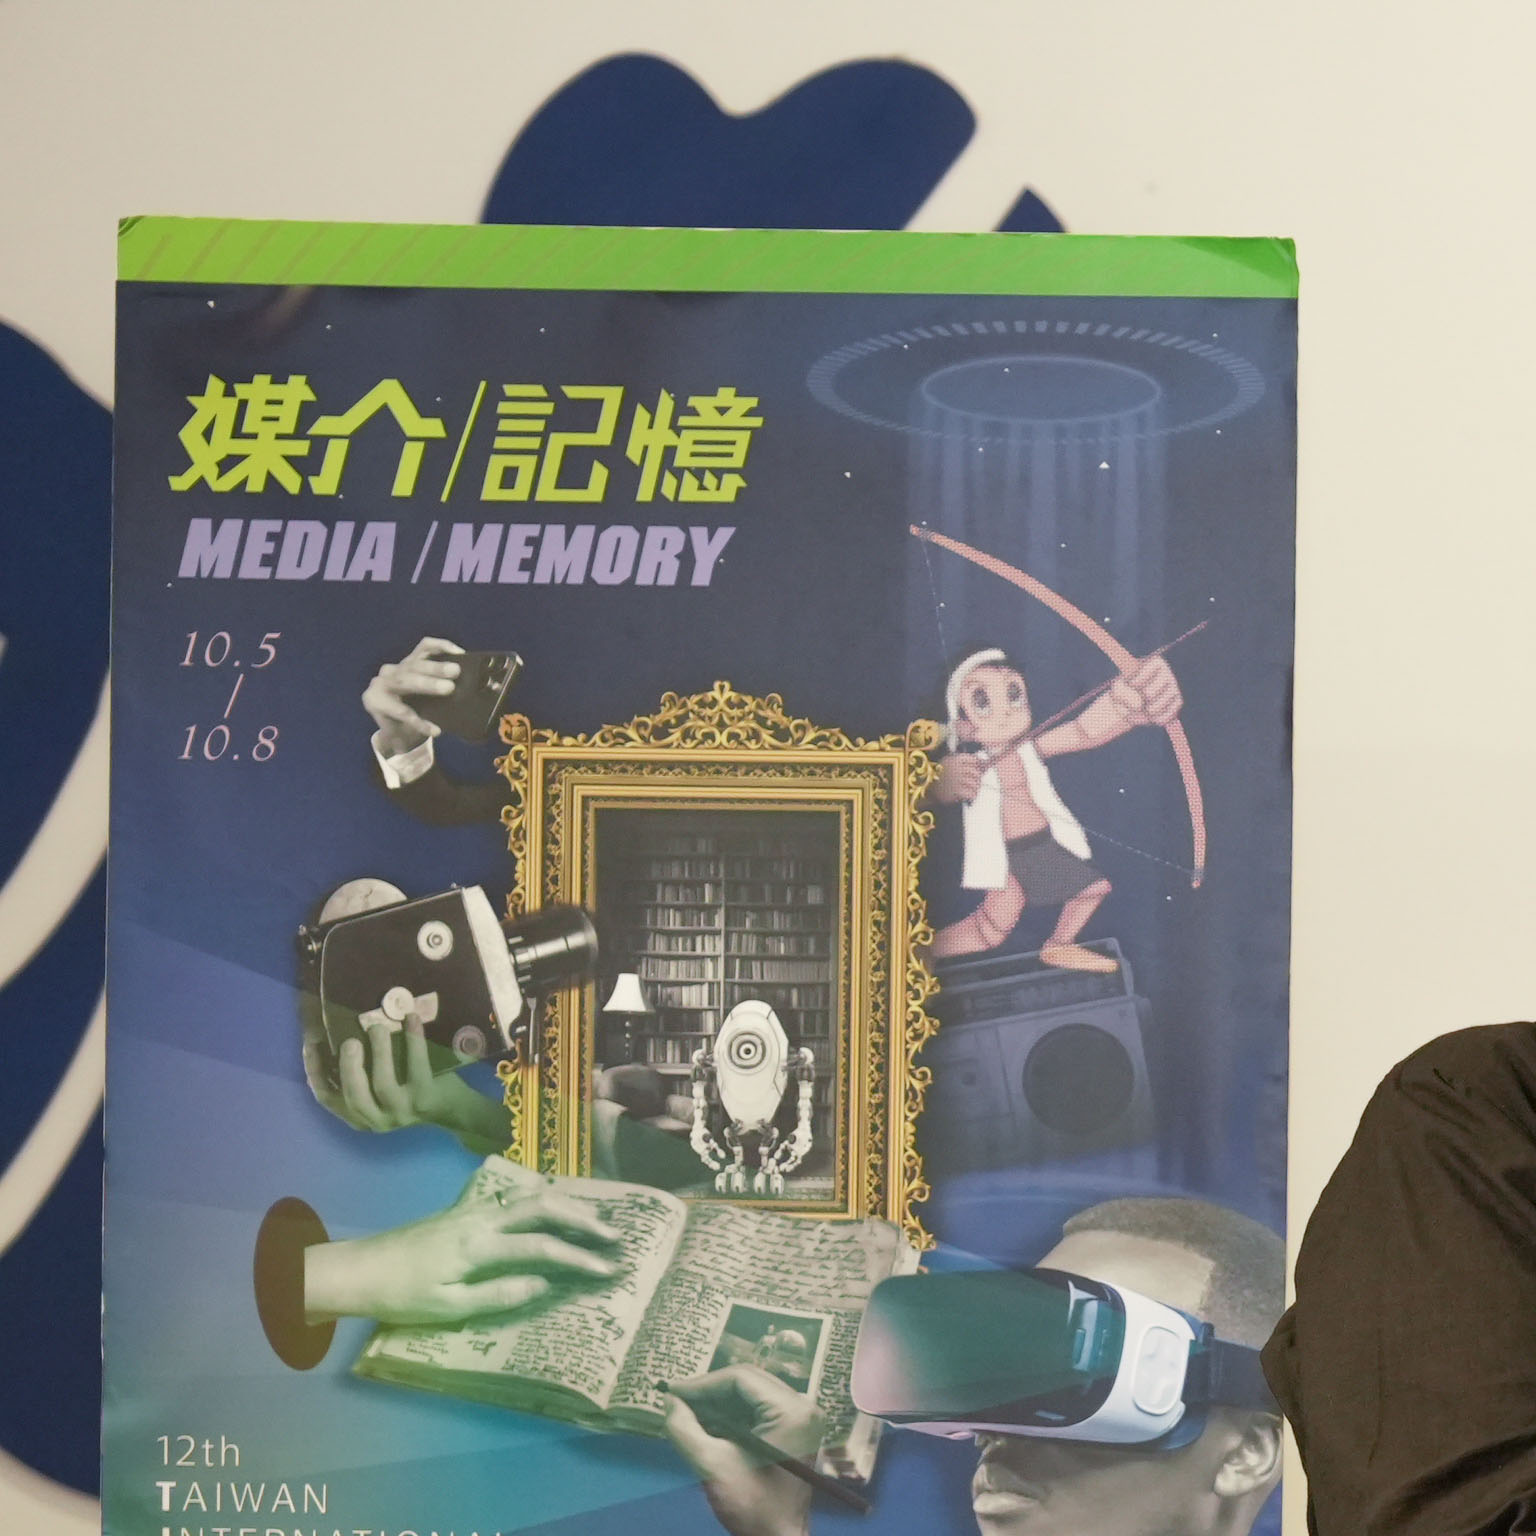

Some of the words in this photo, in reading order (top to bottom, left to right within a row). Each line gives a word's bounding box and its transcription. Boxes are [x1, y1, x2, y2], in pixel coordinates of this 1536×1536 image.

[177, 517, 397, 582] MEDIA
[440, 522, 736, 587] MEMORY
[178, 631, 281, 667] 10.5
[177, 725, 280, 762] 10.8
[156, 1435, 241, 1468] 12th
[156, 1481, 327, 1514] TAIWAN
